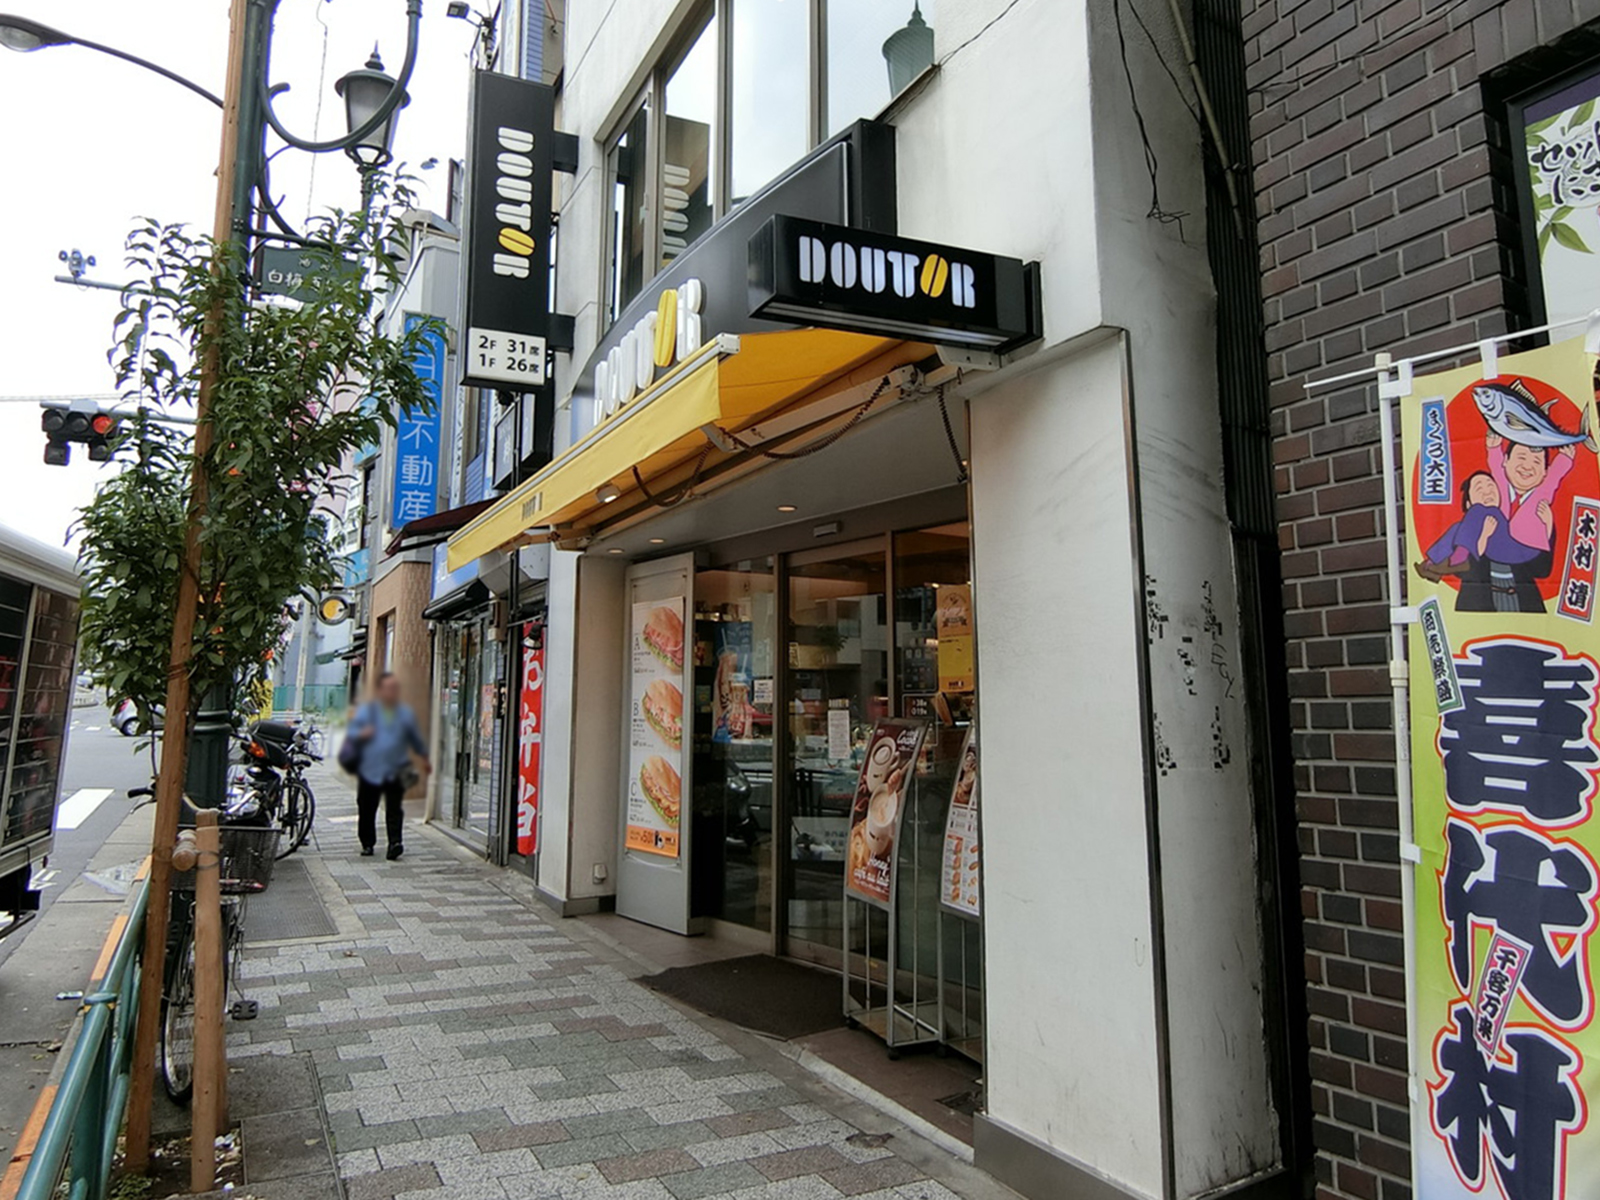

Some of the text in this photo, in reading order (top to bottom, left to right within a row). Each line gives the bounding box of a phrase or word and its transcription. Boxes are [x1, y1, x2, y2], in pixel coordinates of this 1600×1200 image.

[494, 126, 535, 279] DOUTOR
[799, 235, 976, 309] DOUTOR
[479, 335, 497, 350] 2F
[479, 353, 496, 368] 1F
[1437, 643, 1600, 1200] 喜代村
